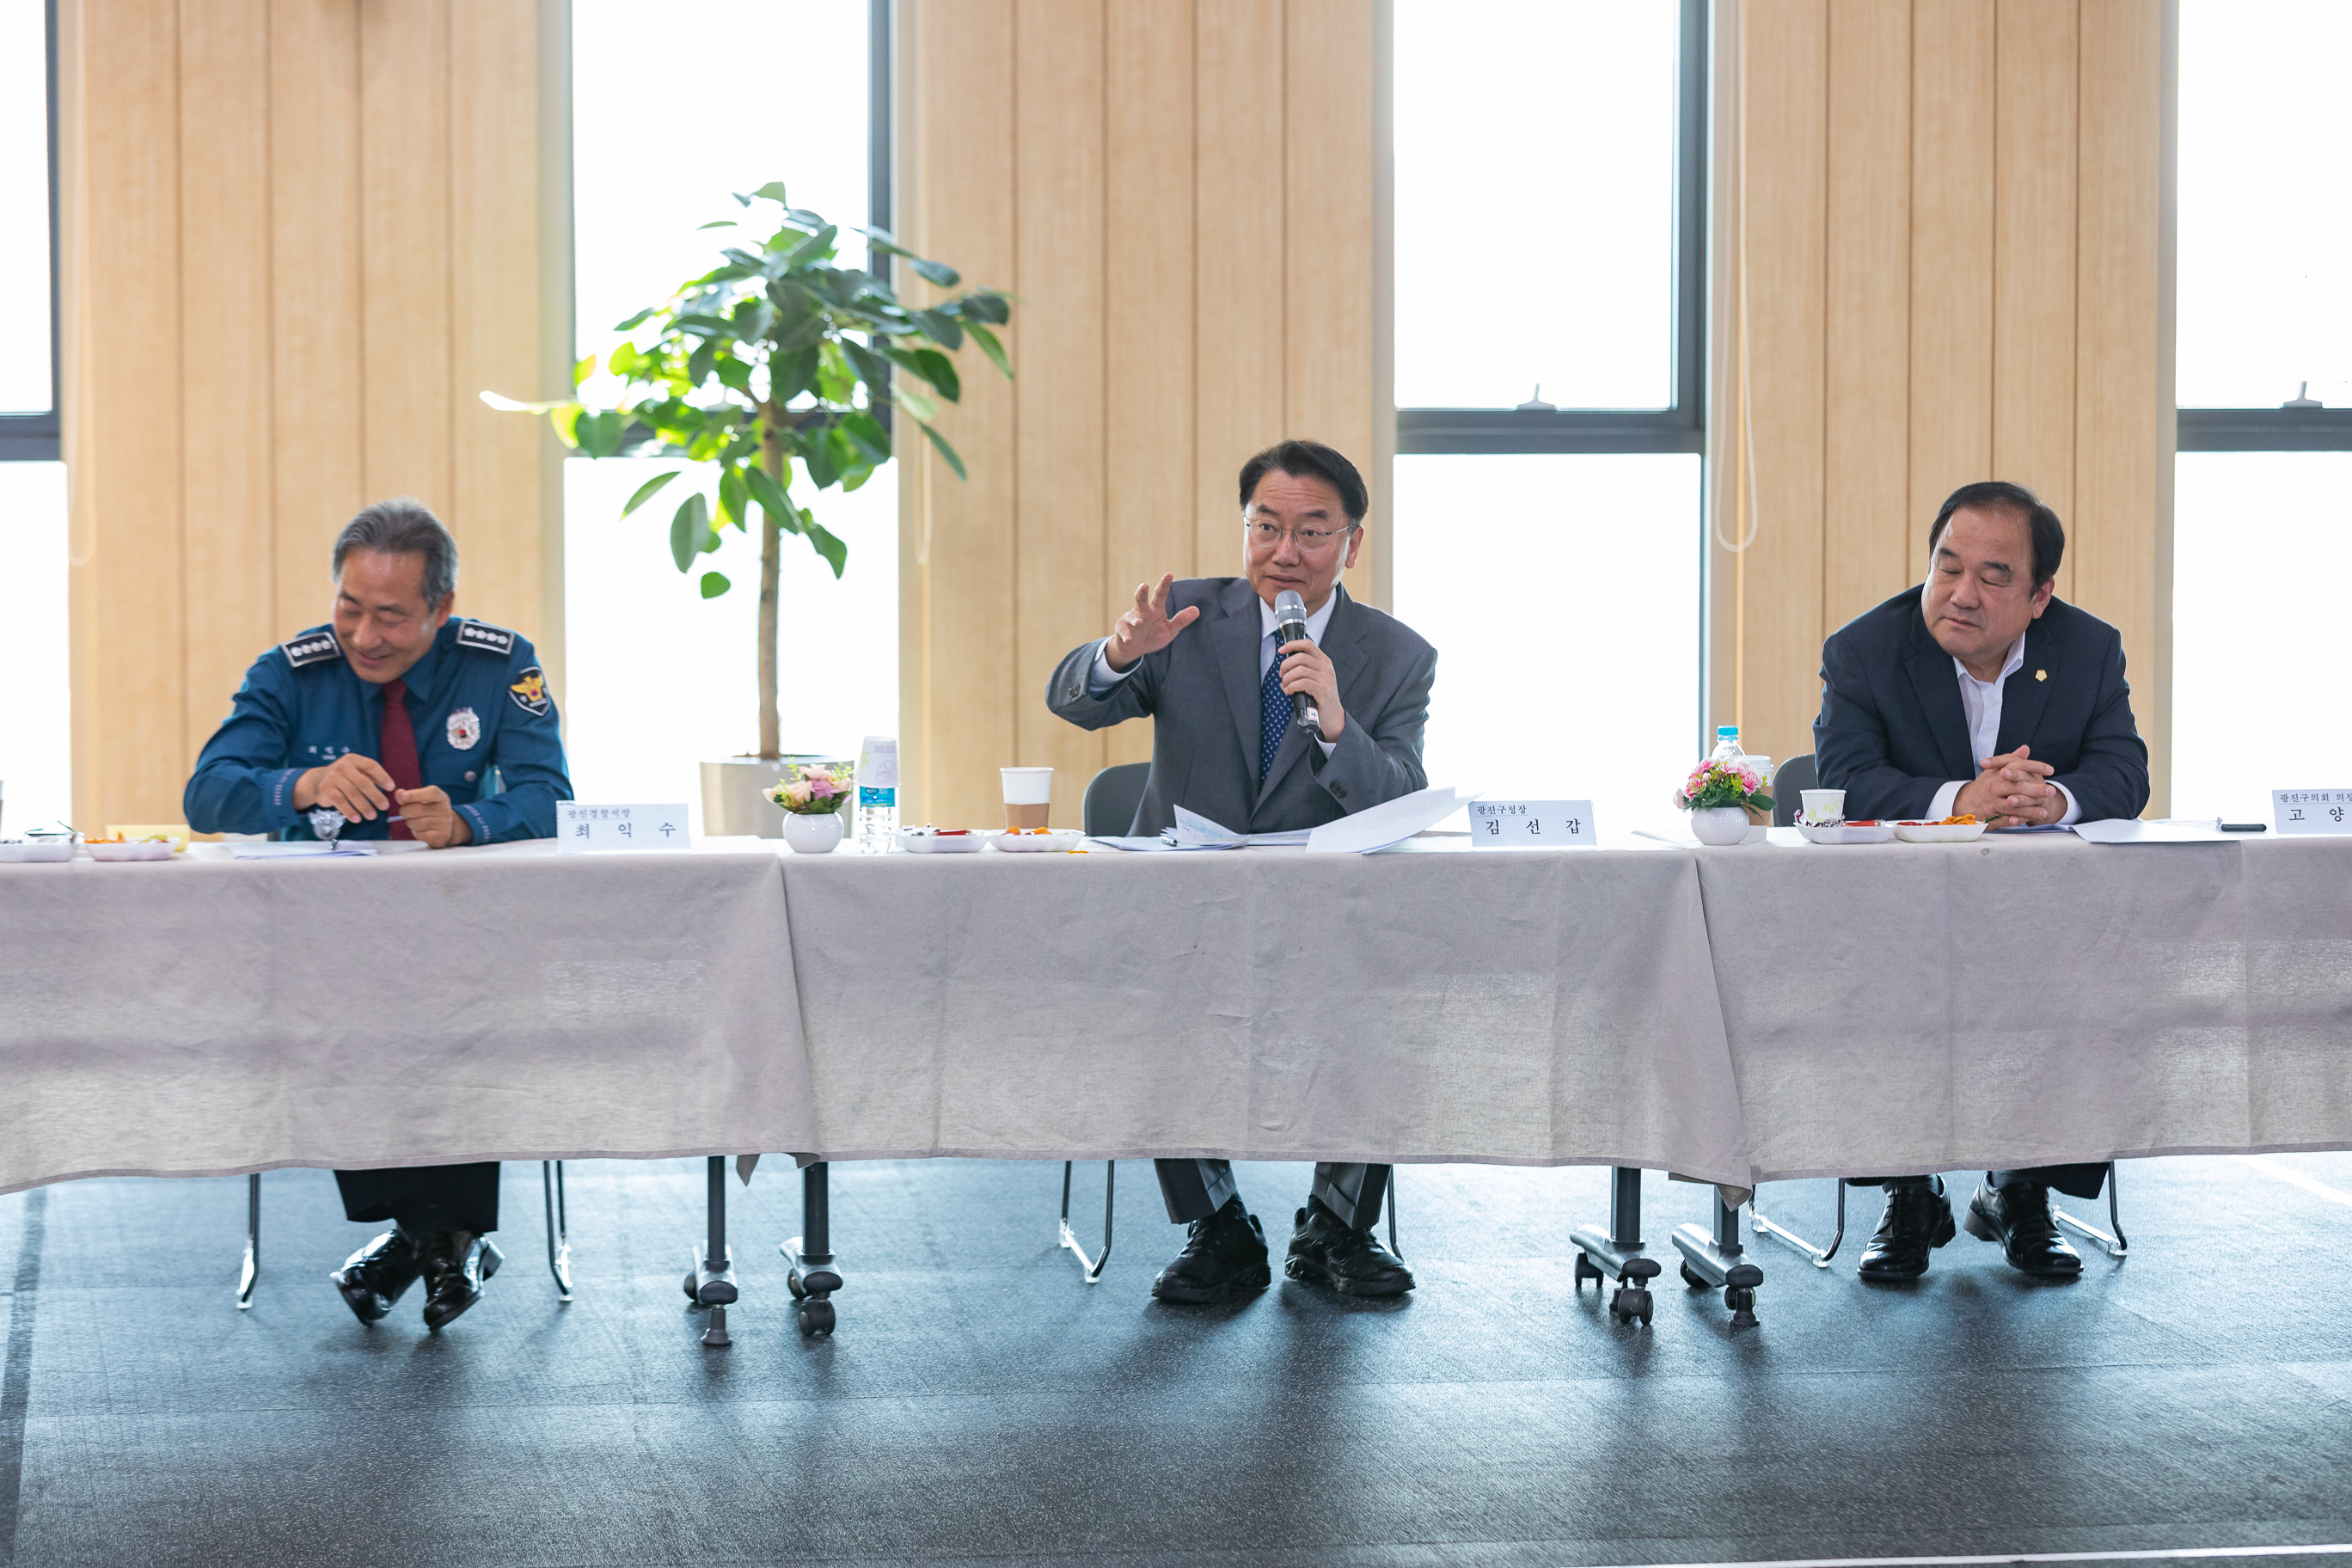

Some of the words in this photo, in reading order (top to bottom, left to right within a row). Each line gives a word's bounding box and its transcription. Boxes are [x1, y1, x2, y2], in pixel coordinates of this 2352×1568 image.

[2280, 793, 2329, 803] 광진구의회
[567, 808, 631, 819] 광진경찰서장
[1477, 805, 1527, 815] 광진구청장
